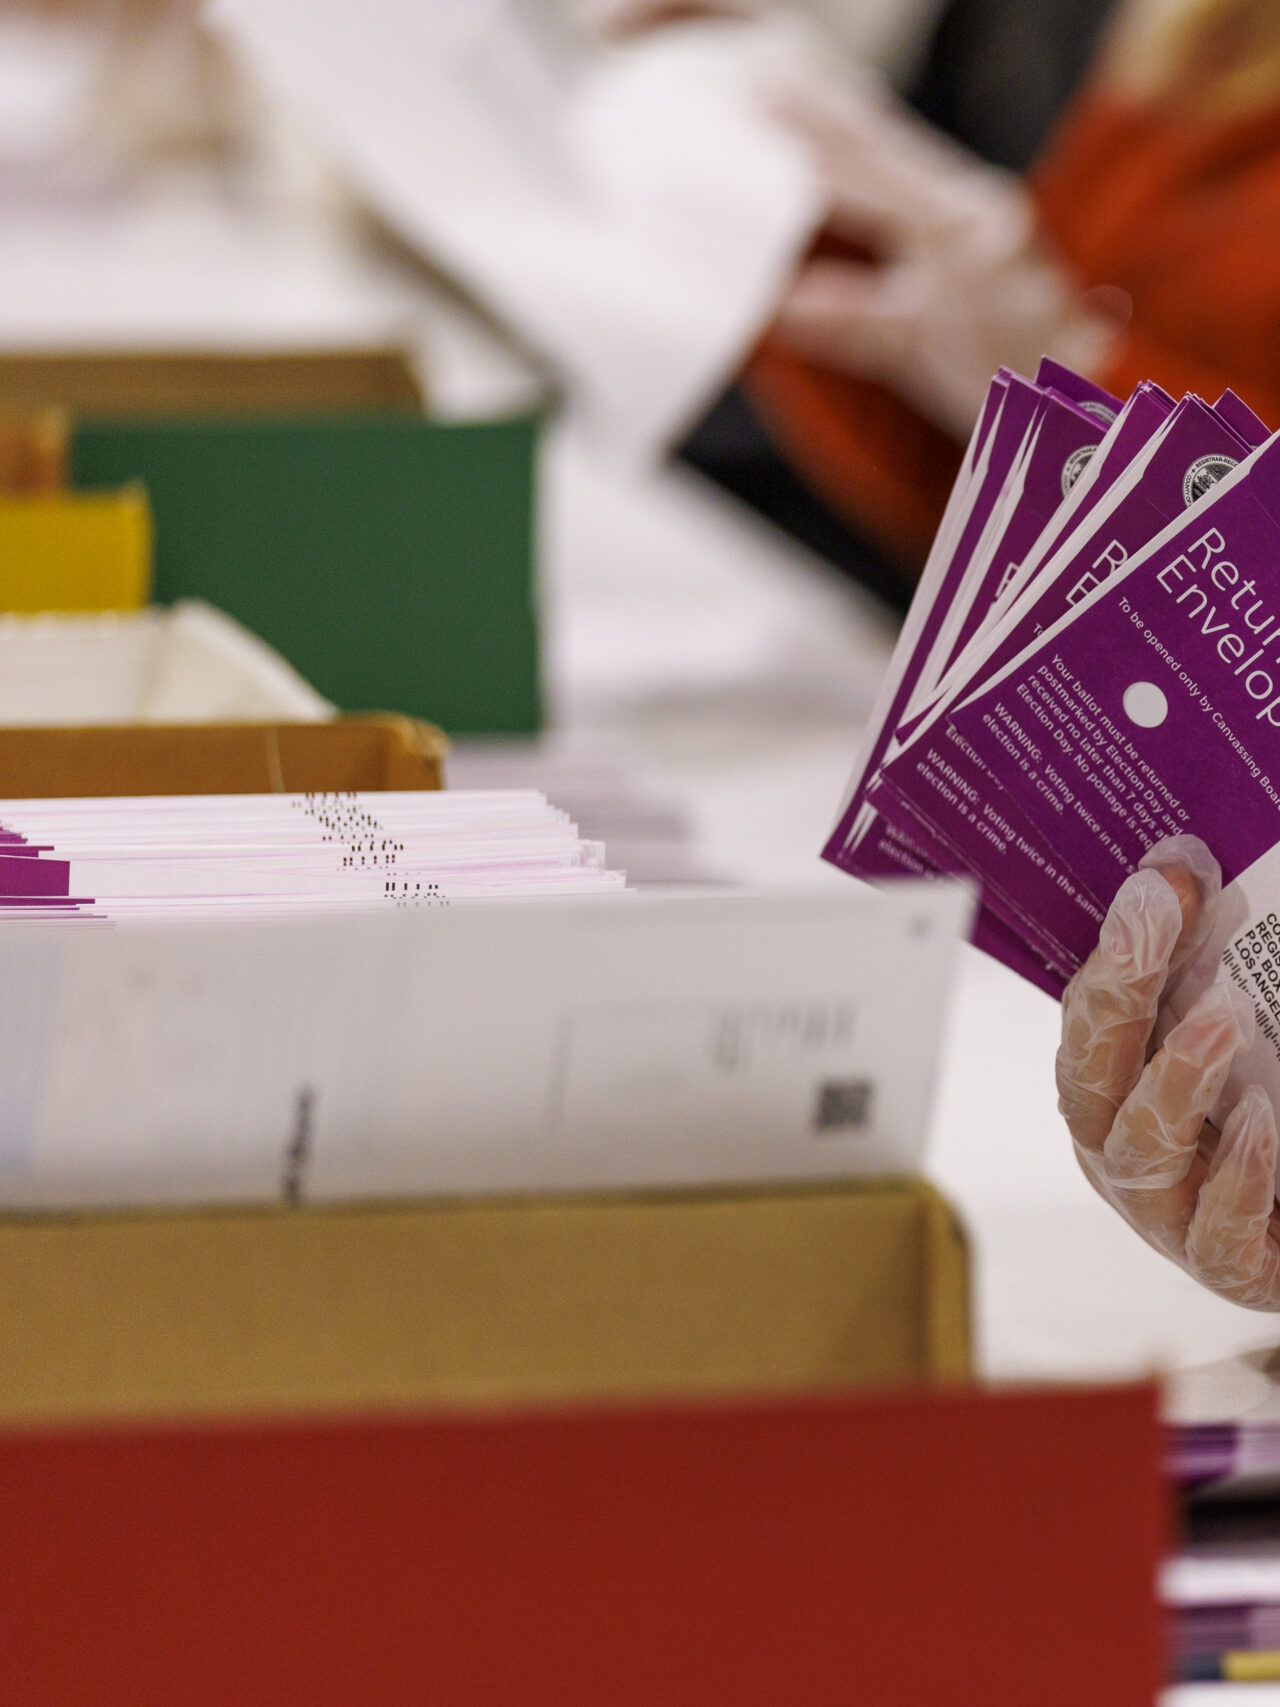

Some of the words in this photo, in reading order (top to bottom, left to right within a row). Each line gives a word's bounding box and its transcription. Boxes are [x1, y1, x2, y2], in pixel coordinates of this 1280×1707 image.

[982, 713, 1020, 759] election
[1018, 757, 1030, 771] is
[1027, 770, 1037, 780] a
[1034, 777, 1067, 816] crime.
[1015, 682, 1054, 730] Election
[1052, 728, 1073, 755] Day.
[1073, 753, 1089, 773] No
[1085, 772, 1127, 816] postage
[1125, 815, 1137, 828] is
[1027, 674, 1069, 723] received
[1065, 722, 1081, 739] no
[1078, 736, 1104, 765] later
[1102, 764, 1126, 792] than
[1125, 790, 1136, 800] 7
[1132, 801, 1156, 829] days
[1036, 664, 1096, 731] postmarked
[1092, 728, 1107, 746] by
[1105, 744, 1144, 790] Election
[1142, 788, 1164, 813] Day
[1160, 810, 1184, 836] and
[1051, 653, 1074, 681] Your
[1071, 680, 1102, 716] ballot
[1099, 715, 1126, 744] must
[1123, 742, 1138, 759] be
[1136, 759, 1180, 808] returned
[1176, 808, 1189, 821] or
[1118, 596, 1131, 613] To
[1129, 610, 1144, 629] be
[1142, 629, 1182, 671] opened
[1178, 671, 1201, 696] only
[1198, 694, 1213, 712] by
[1211, 711, 1261, 778] Canvassing
[916, 762, 958, 804] election
[974, 819, 1010, 855] crime.
[924, 747, 983, 806] WARNING:
[983, 803, 1016, 841] Voting
[1015, 836, 1045, 865] twice
[1044, 864, 1056, 878] in
[1056, 874, 1075, 894] the
[1074, 891, 1106, 923] same
[994, 702, 1042, 761] WARNING:
[1044, 763, 1075, 803] Voting
[1073, 800, 1100, 831] twice
[1098, 831, 1111, 845] in
[1109, 843, 1127, 863] the
[1234, 937, 1256, 970] LOS
[1244, 929, 1262, 959] P.O.
